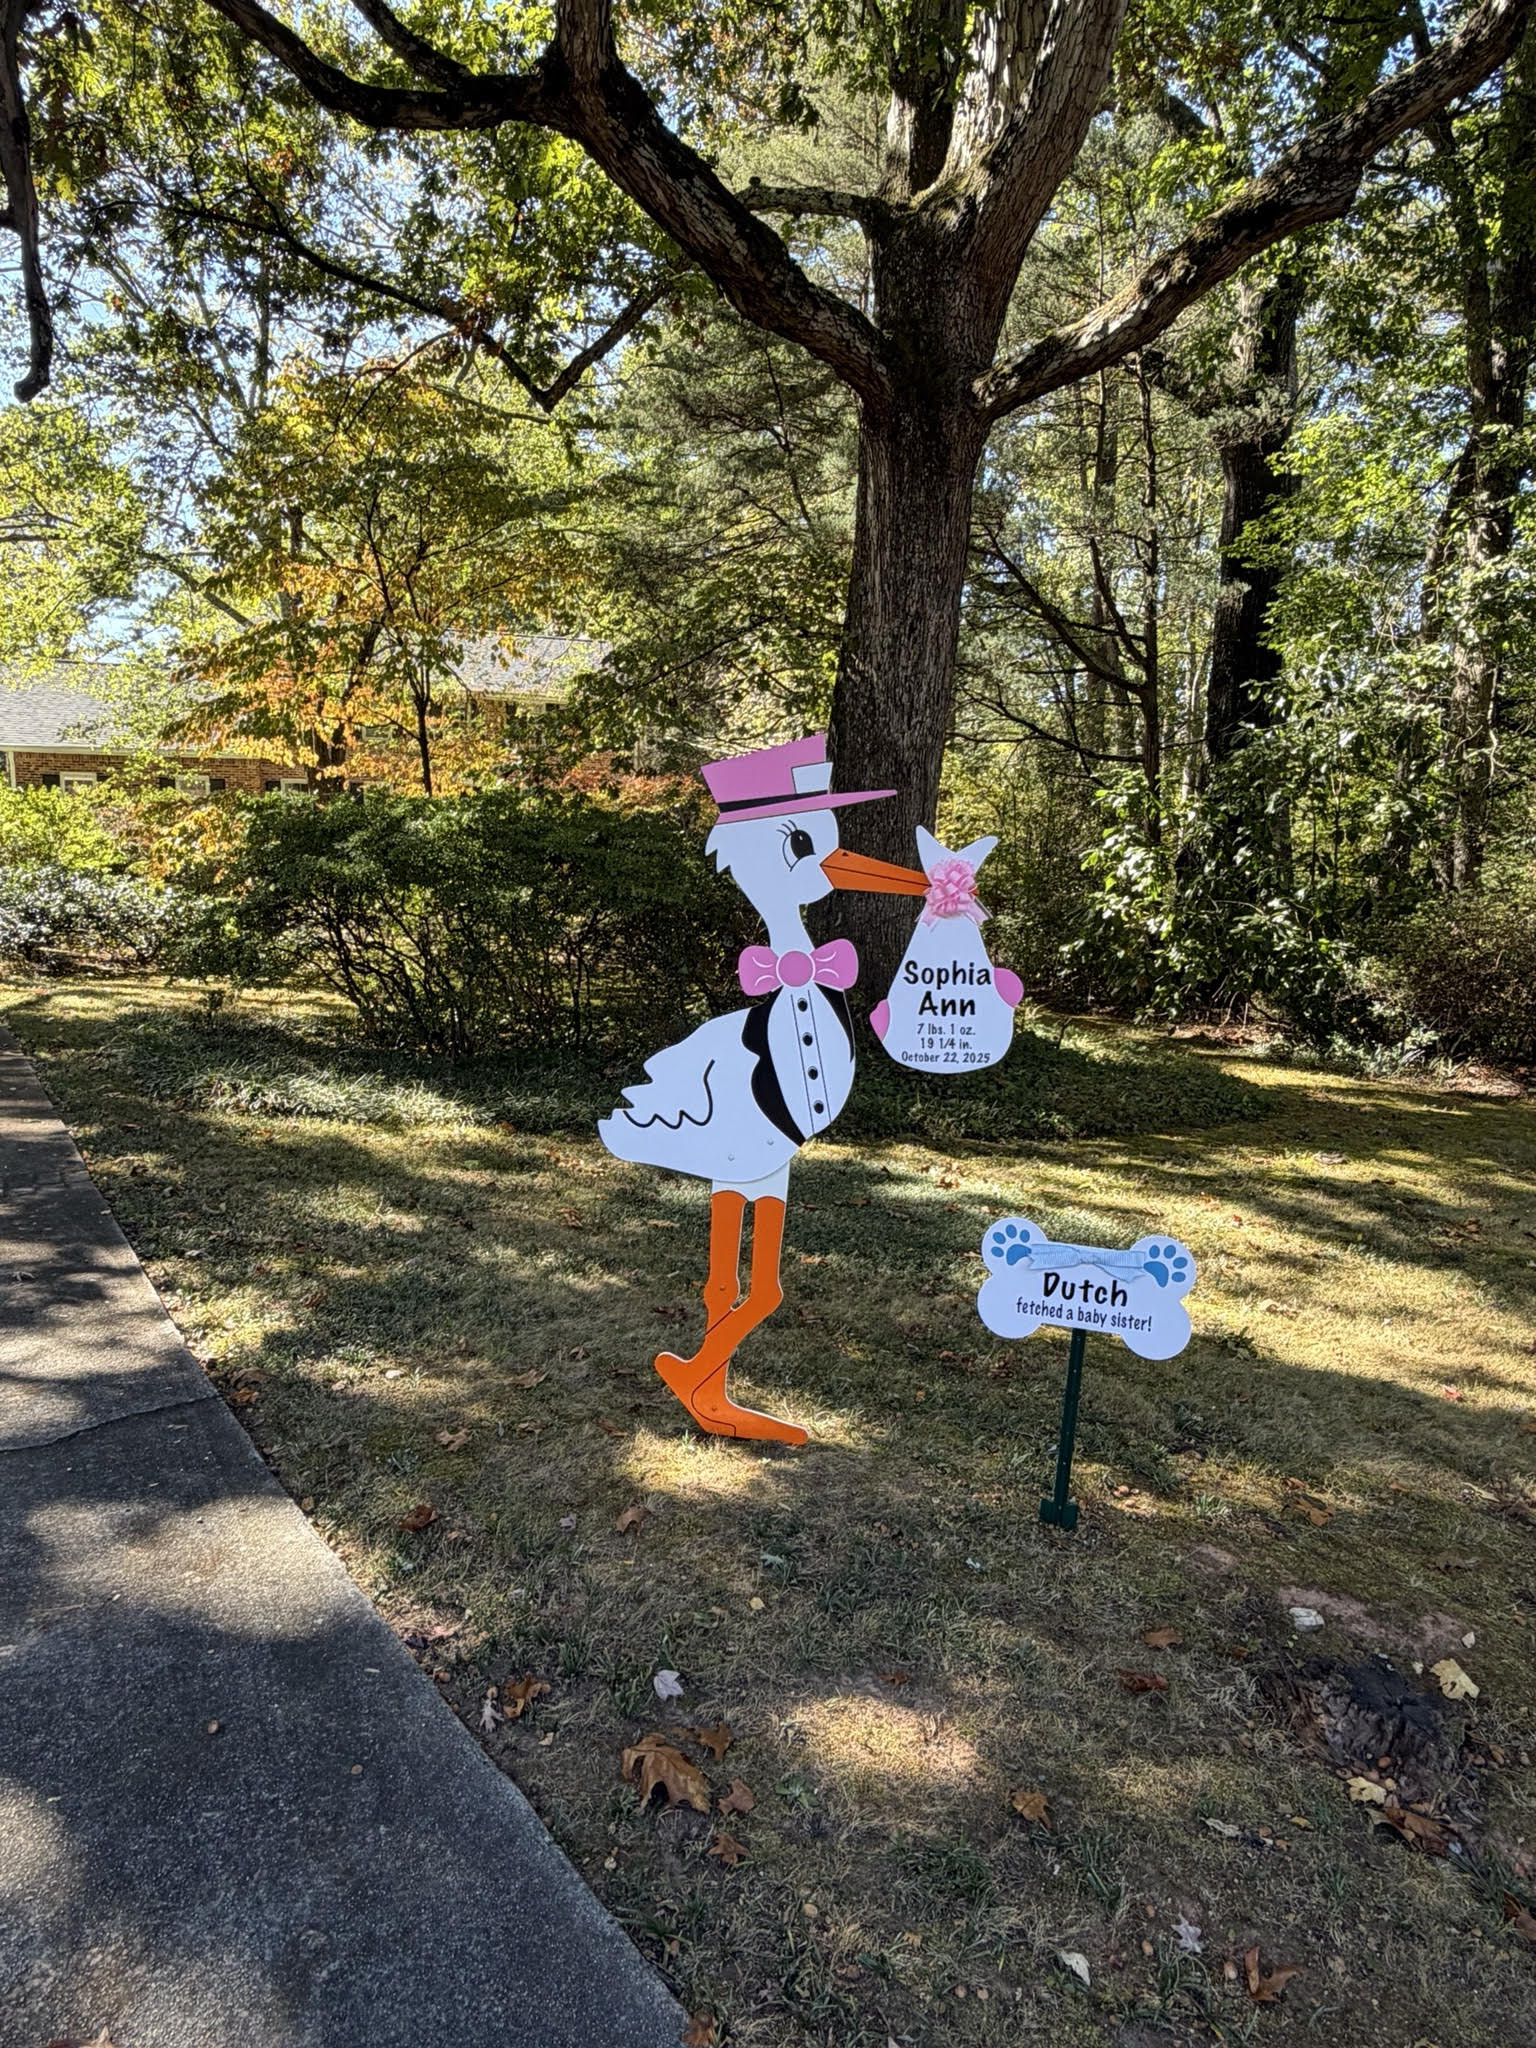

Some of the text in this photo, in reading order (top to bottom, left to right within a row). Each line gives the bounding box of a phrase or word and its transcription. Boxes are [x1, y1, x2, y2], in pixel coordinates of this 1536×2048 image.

[903, 960, 991, 990] Sophia
[918, 991, 976, 1017] Ann
[917, 1023, 976, 1035] 7 lbs. 1 oz.
[920, 1038, 972, 1050] 19 1/4 in.
[901, 1051, 990, 1064] October 22, 2025
[1043, 1272, 1128, 1307] Dutch
[1016, 1297, 1152, 1332] fetched a baby sister!
